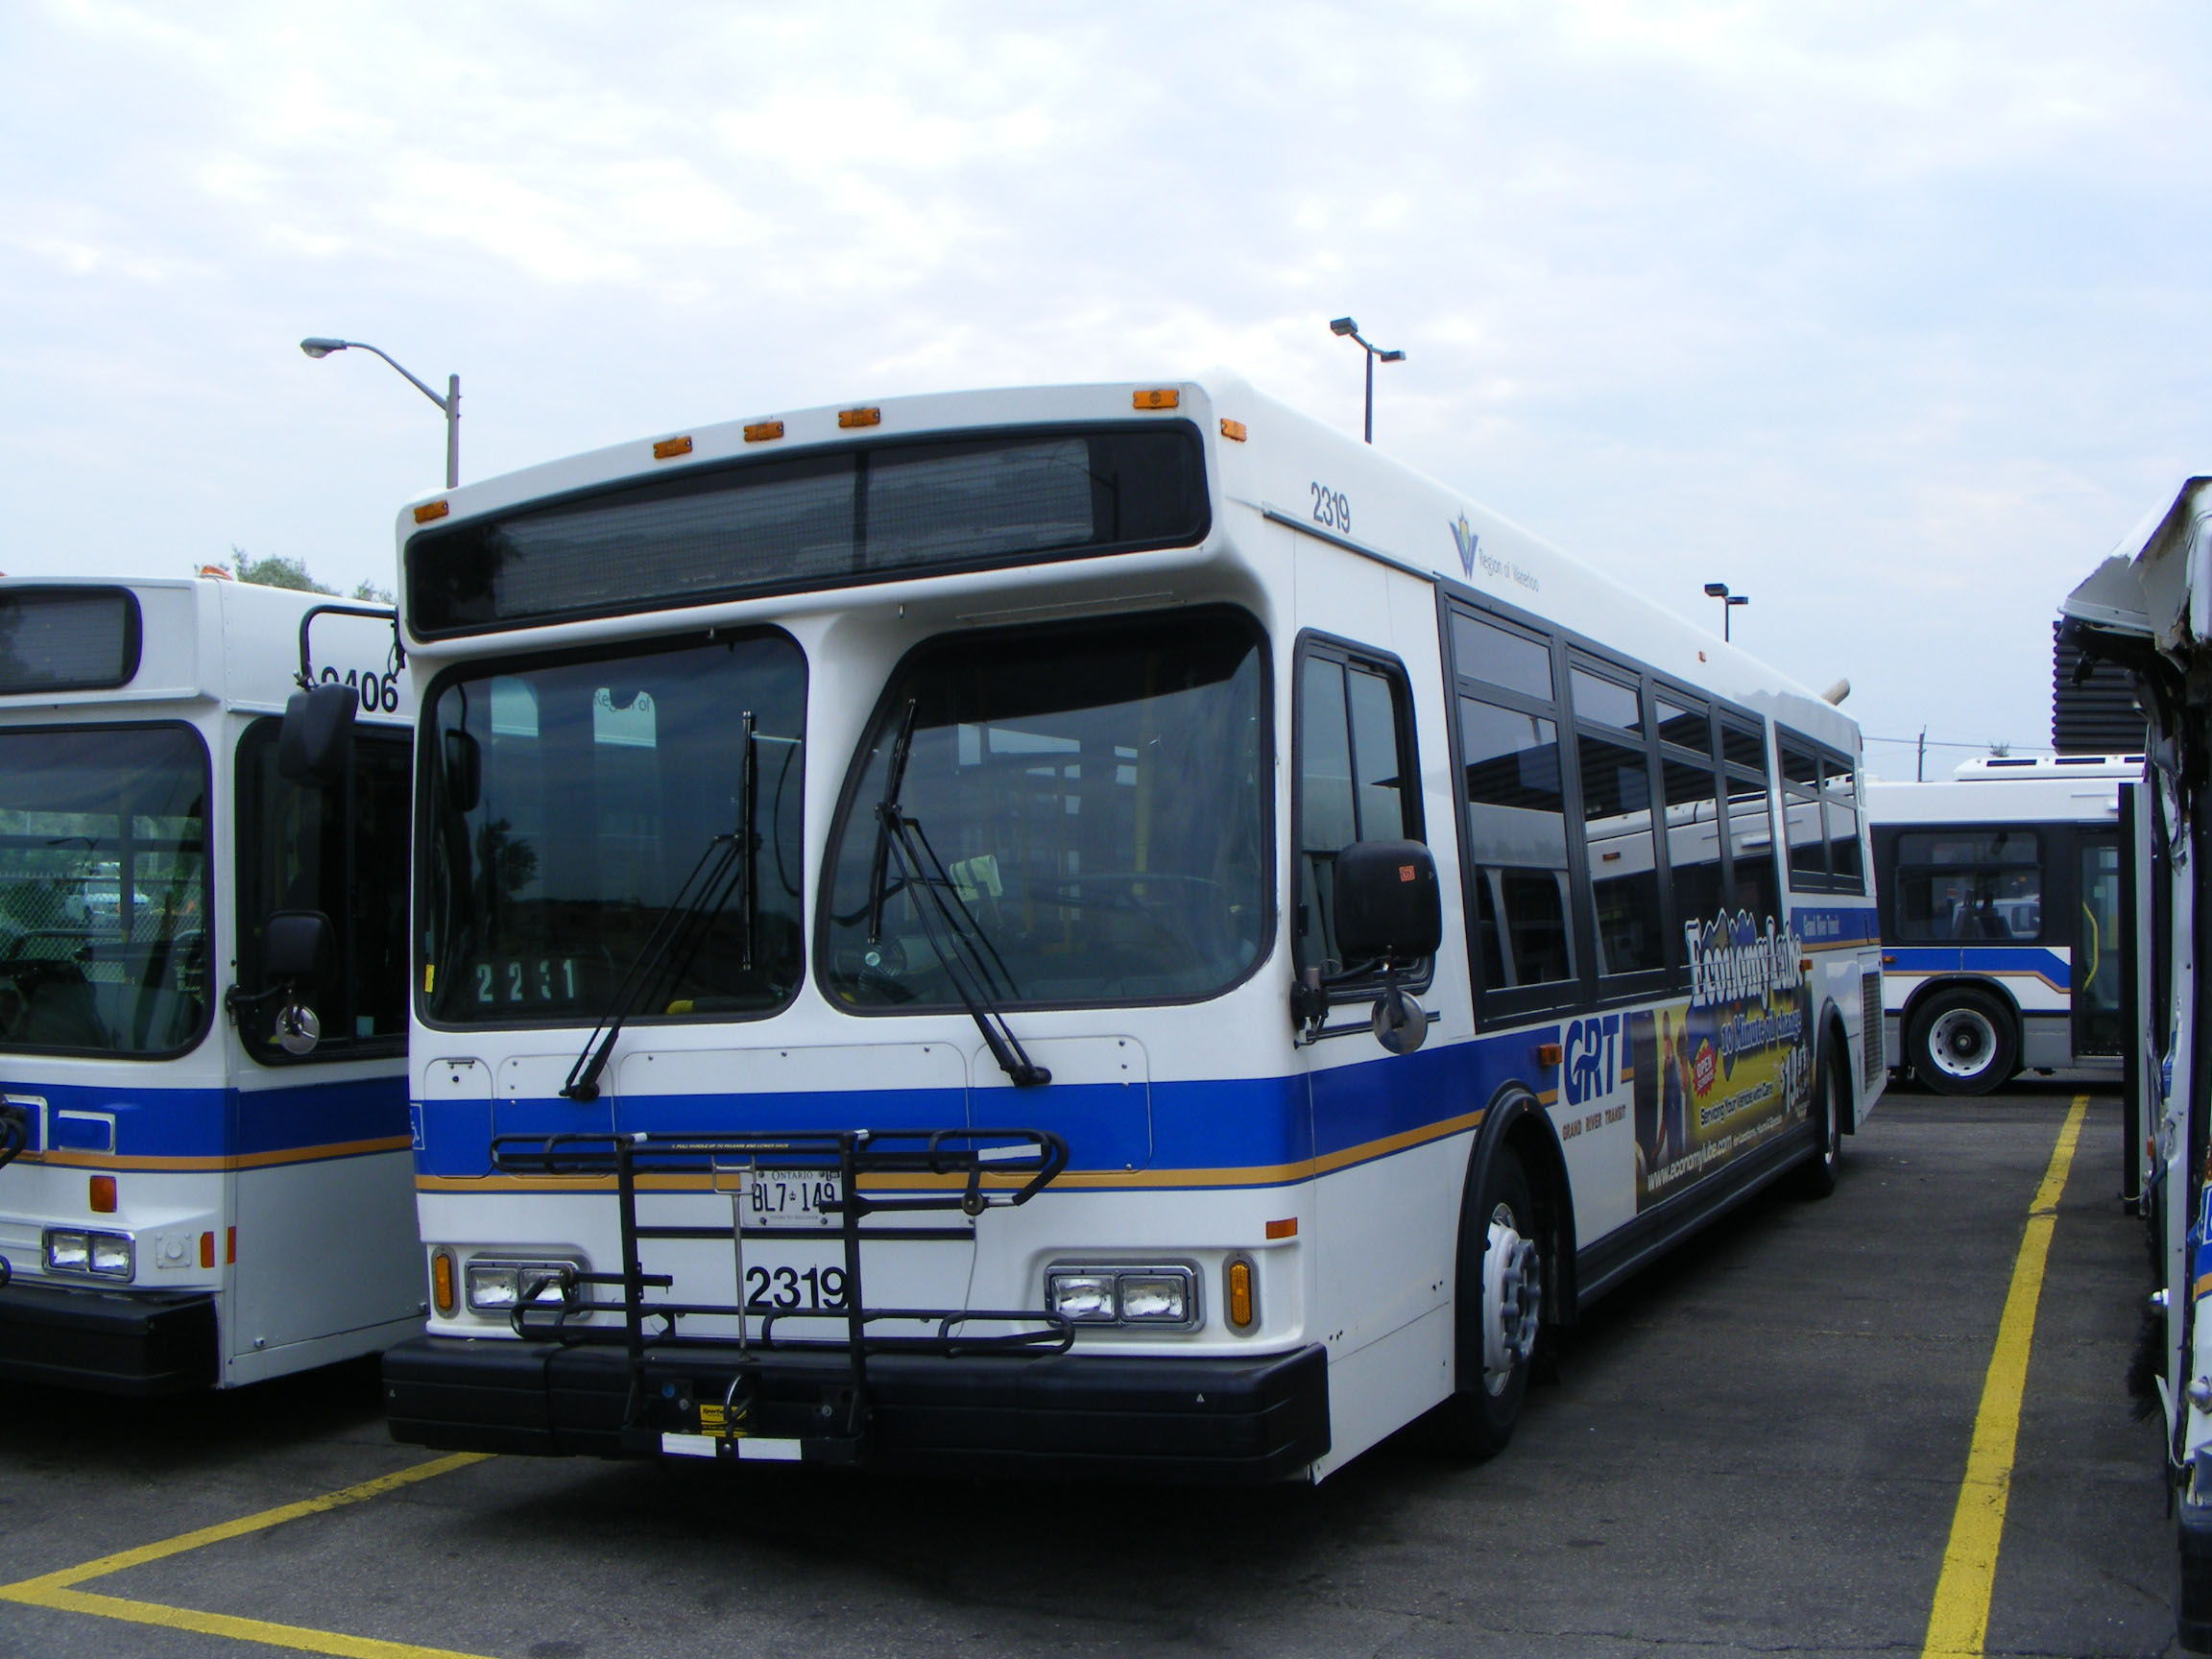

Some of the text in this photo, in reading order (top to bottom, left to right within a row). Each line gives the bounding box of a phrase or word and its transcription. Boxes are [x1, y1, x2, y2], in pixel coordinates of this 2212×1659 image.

[1310, 481, 1351, 534] 2319
[1686, 918, 1768, 1010] Economy
[1734, 1013, 1766, 1052] Minute
[1564, 1014, 1620, 1106] GRT
[1696, 1056, 1713, 1077] OPEN
[1562, 1104, 1626, 1141] GRAND RIVER TRANSIT
[1700, 1100, 1724, 1129] Servicing
[1724, 1094, 1737, 1115] Your
[1647, 1135, 1733, 1191] www.economylube.com
[752, 1182, 786, 1212] BL7
[746, 1265, 849, 1310] 2319
